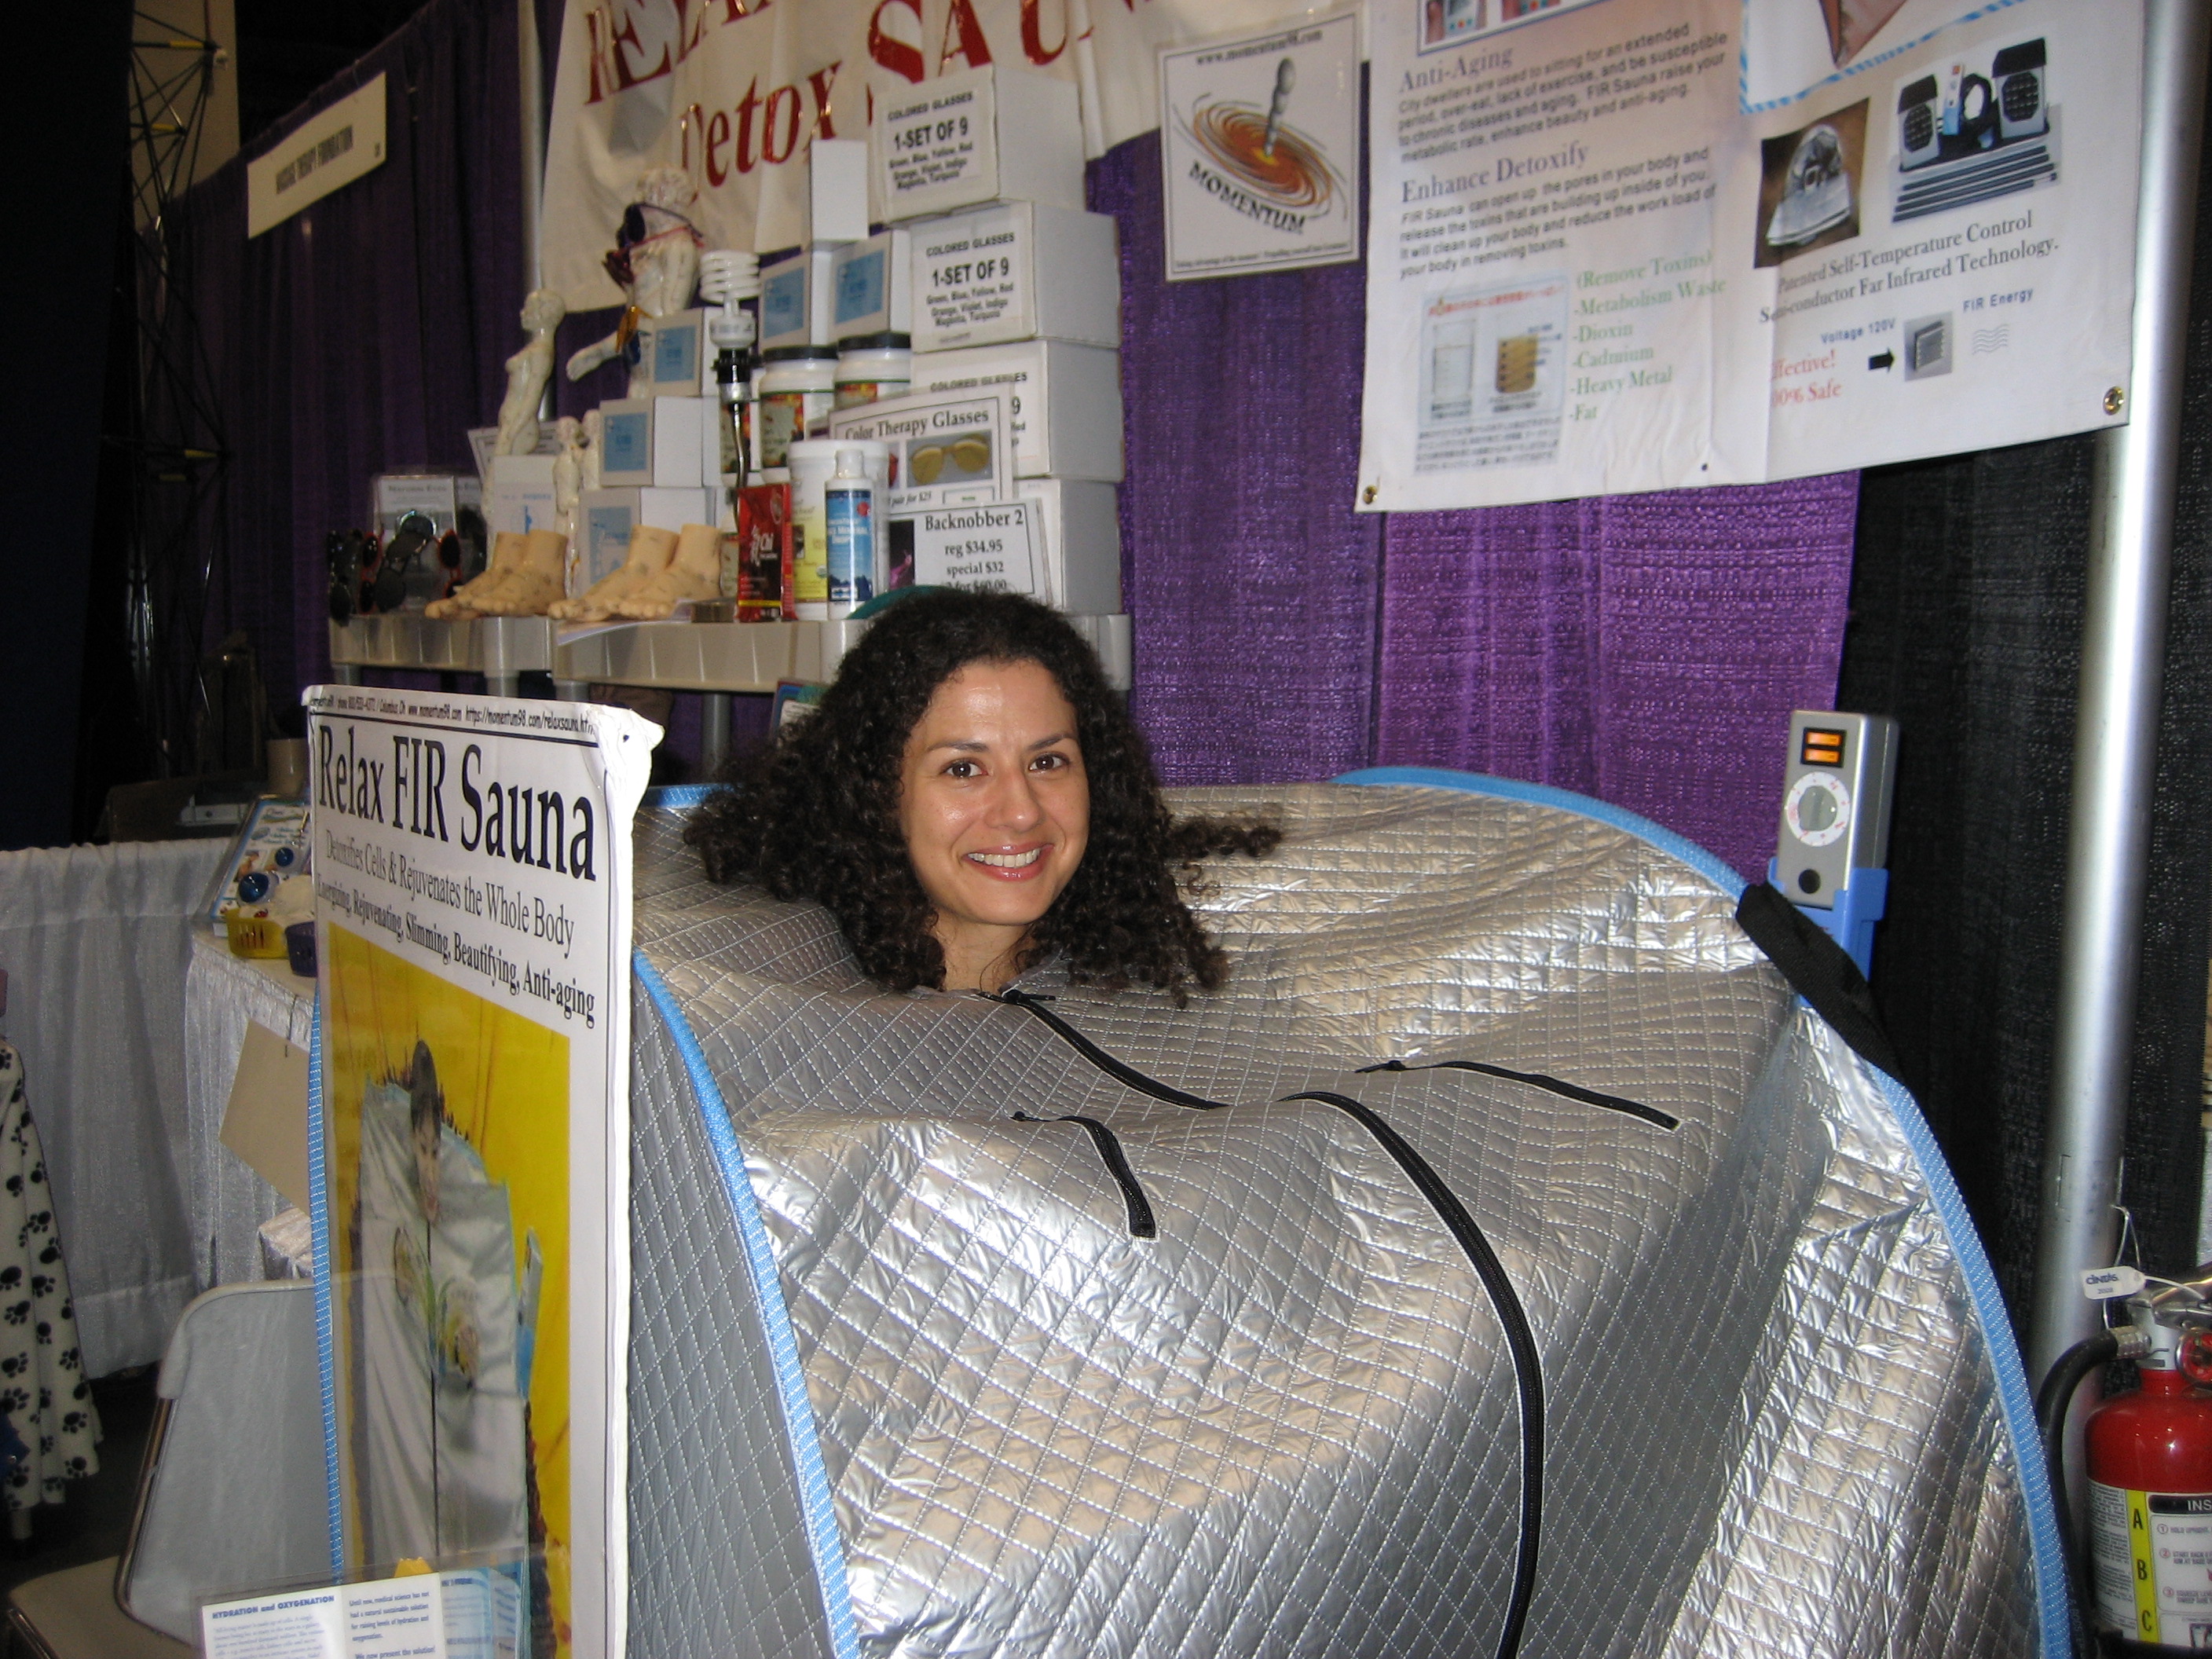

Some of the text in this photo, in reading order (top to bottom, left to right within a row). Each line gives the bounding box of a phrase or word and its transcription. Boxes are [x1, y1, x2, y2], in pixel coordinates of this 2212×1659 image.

[1624, 22, 1689, 52] extended
[1601, 58, 1627, 76] and
[1629, 55, 1646, 70] be
[1650, 32, 1727, 64] susceptible
[1399, 48, 1513, 93] Anti-Aging
[888, 102, 928, 122] COLORED
[932, 90, 973, 110] GLASSES
[1458, 110, 1513, 133] diseases
[1514, 101, 1538, 119] and
[1587, 81, 1609, 101] FIR
[1613, 71, 1657, 93] Sauna
[1660, 62, 1694, 81] raise
[1696, 52, 1726, 74] your
[895, 115, 969, 151] 1-SET OF 9
[1401, 146, 1709, 224] FIR Sauna can open up the pores in your body and
[1402, 139, 1589, 203] Enhance Detoxify
[1189, 159, 1307, 235] MOMENTUM
[1400, 226, 1445, 240] release
[1448, 222, 1467, 234] the
[1469, 214, 1503, 229] toxins
[1504, 207, 1528, 222] that
[1529, 203, 1550, 216] are
[1552, 192, 1601, 211] building
[1603, 189, 1621, 202] up
[1622, 179, 1662, 196] inside
[1664, 172, 1679, 188] of
[1411, 244, 1431, 257] will
[1433, 240, 1466, 254] clean
[1468, 236, 1483, 249] up
[1485, 230, 1510, 247] your
[1511, 223, 1540, 239] body
[1543, 217, 1566, 232] and
[1569, 209, 1611, 227] reduce
[1613, 203, 1635, 218] the
[1637, 196, 1669, 212] work
[1672, 189, 1701, 205] load
[926, 231, 1015, 257] COLORED GLASSES
[1830, 233, 1962, 275] Self-Temperature
[1966, 209, 2033, 243] Control
[932, 256, 1009, 287] 1-SET OF 9
[1401, 263, 1426, 280] your
[1428, 258, 1457, 273] body
[1460, 256, 1472, 267] in
[1473, 245, 1526, 265] removing
[1859, 277, 1882, 296] Far
[1887, 259, 1953, 290] Infrared
[1956, 238, 2060, 273] Technology.
[1577, 267, 1646, 289] (Remove
[1677, 279, 1727, 298] Waste
[1963, 288, 2034, 312] FIR Energy
[1821, 317, 1895, 345] Voltage 120V
[1629, 364, 1673, 387] Metal
[1807, 377, 1843, 401] Safe
[1011, 395, 1021, 415] 9
[876, 418, 928, 436] Therapy
[932, 408, 990, 428] Glasses
[925, 509, 1024, 531] Backnobber 2
[945, 539, 1003, 558] reg $34.95
[946, 561, 1004, 578] special $32
[319, 724, 597, 881] Relax FIR Sauna
[326, 829, 575, 959] Detoxifies Cells & Rejuvenates the Whole Body
[405, 910, 452, 965] Slimming,
[453, 931, 520, 996] Beautifying,
[522, 959, 595, 1030] Anti-aging
[2133, 1507, 2144, 1530] A
[2137, 1558, 2148, 1580] B
[212, 1595, 335, 1619] HYDRATION and OXYGENATION
[2141, 1610, 2152, 1632] C
